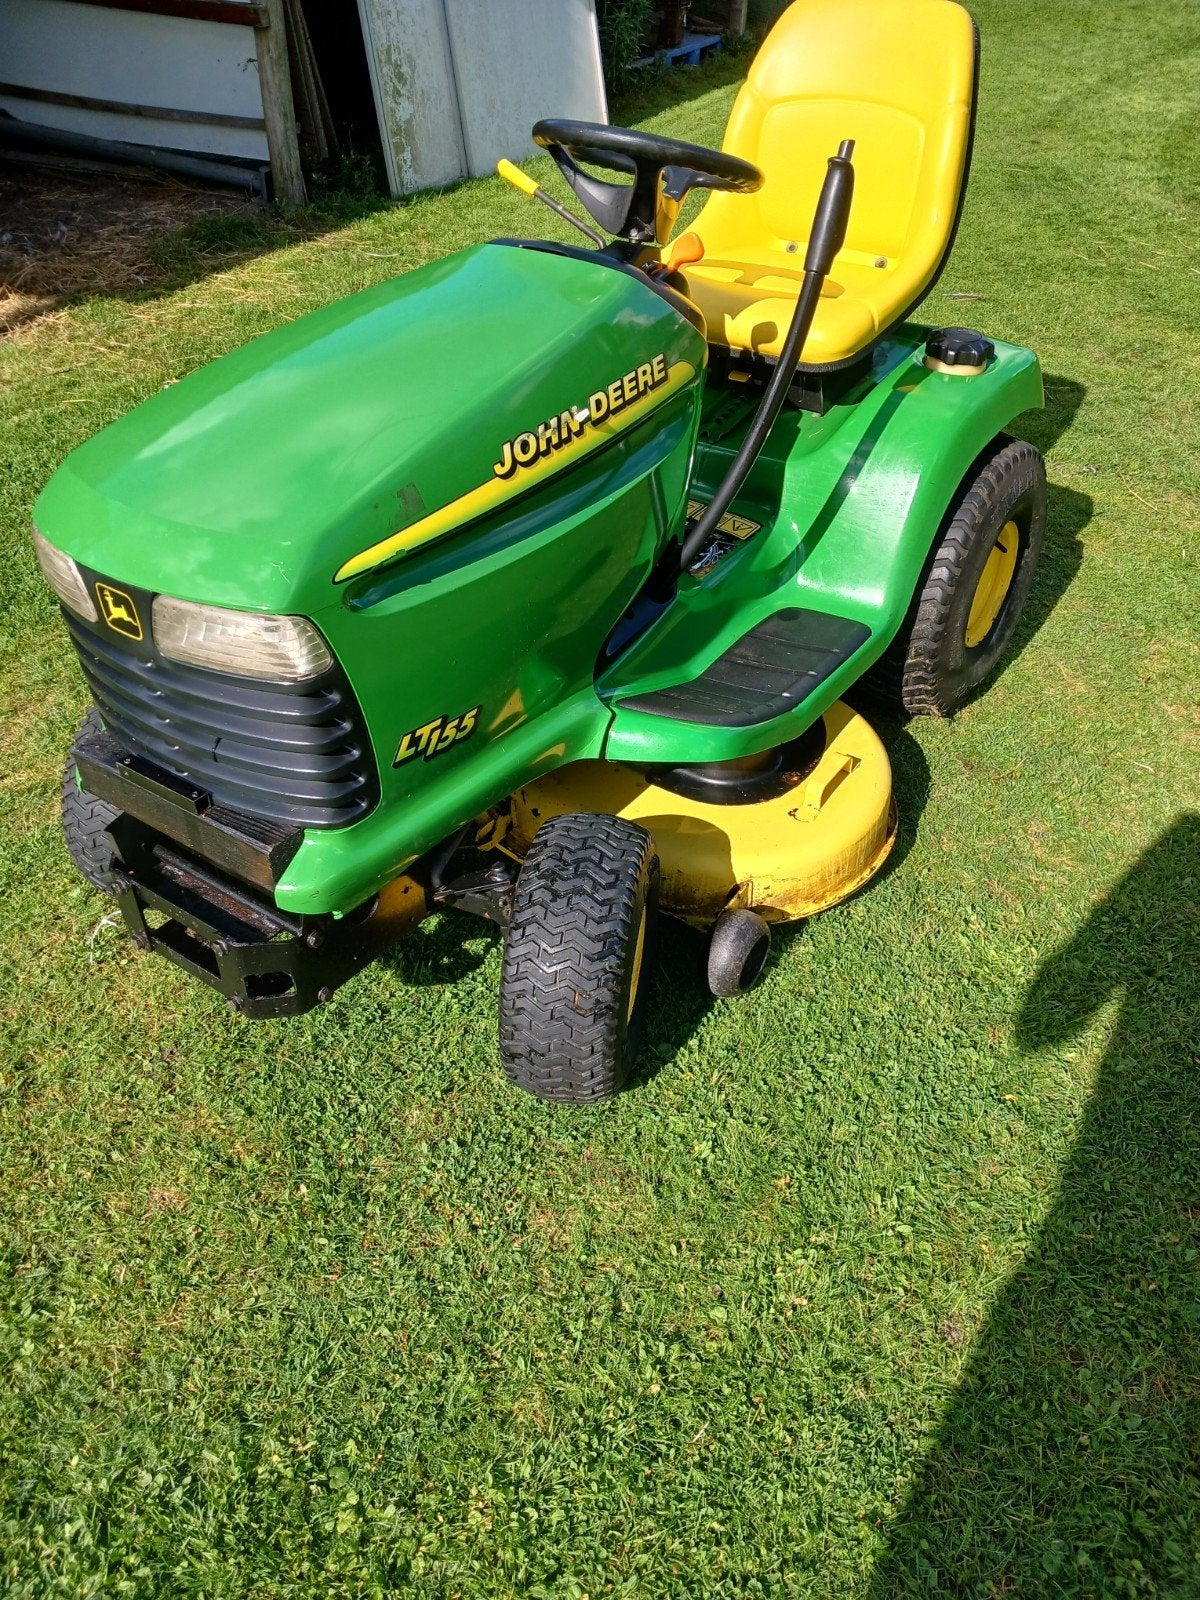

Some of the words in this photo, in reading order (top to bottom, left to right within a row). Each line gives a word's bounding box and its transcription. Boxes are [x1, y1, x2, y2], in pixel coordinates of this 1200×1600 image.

[493, 405, 585, 478] JOHN
[588, 353, 668, 426] DEERE
[393, 705, 480, 765] LT155
